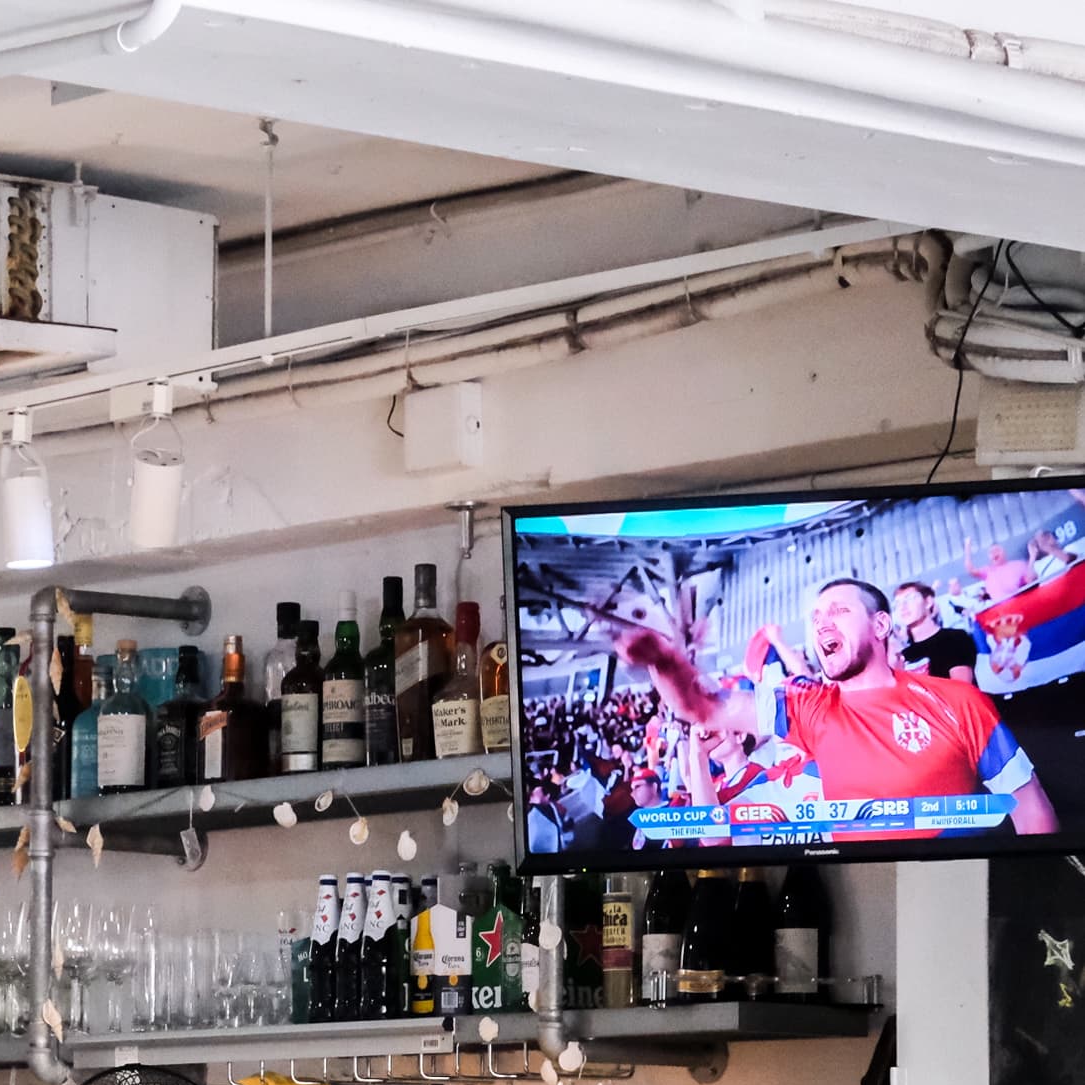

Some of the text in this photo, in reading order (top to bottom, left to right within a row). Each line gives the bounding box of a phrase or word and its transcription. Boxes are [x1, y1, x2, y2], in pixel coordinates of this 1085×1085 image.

[440, 717, 467, 728] Mark
[638, 810, 708, 824] WORLD CUP
[734, 805, 773, 823] GER
[795, 803, 816, 820] 36
[829, 802, 848, 819] 37
[871, 799, 910, 816] SRB
[920, 801, 940, 813] 2nd
[671, 827, 706, 837] THE FINAL
